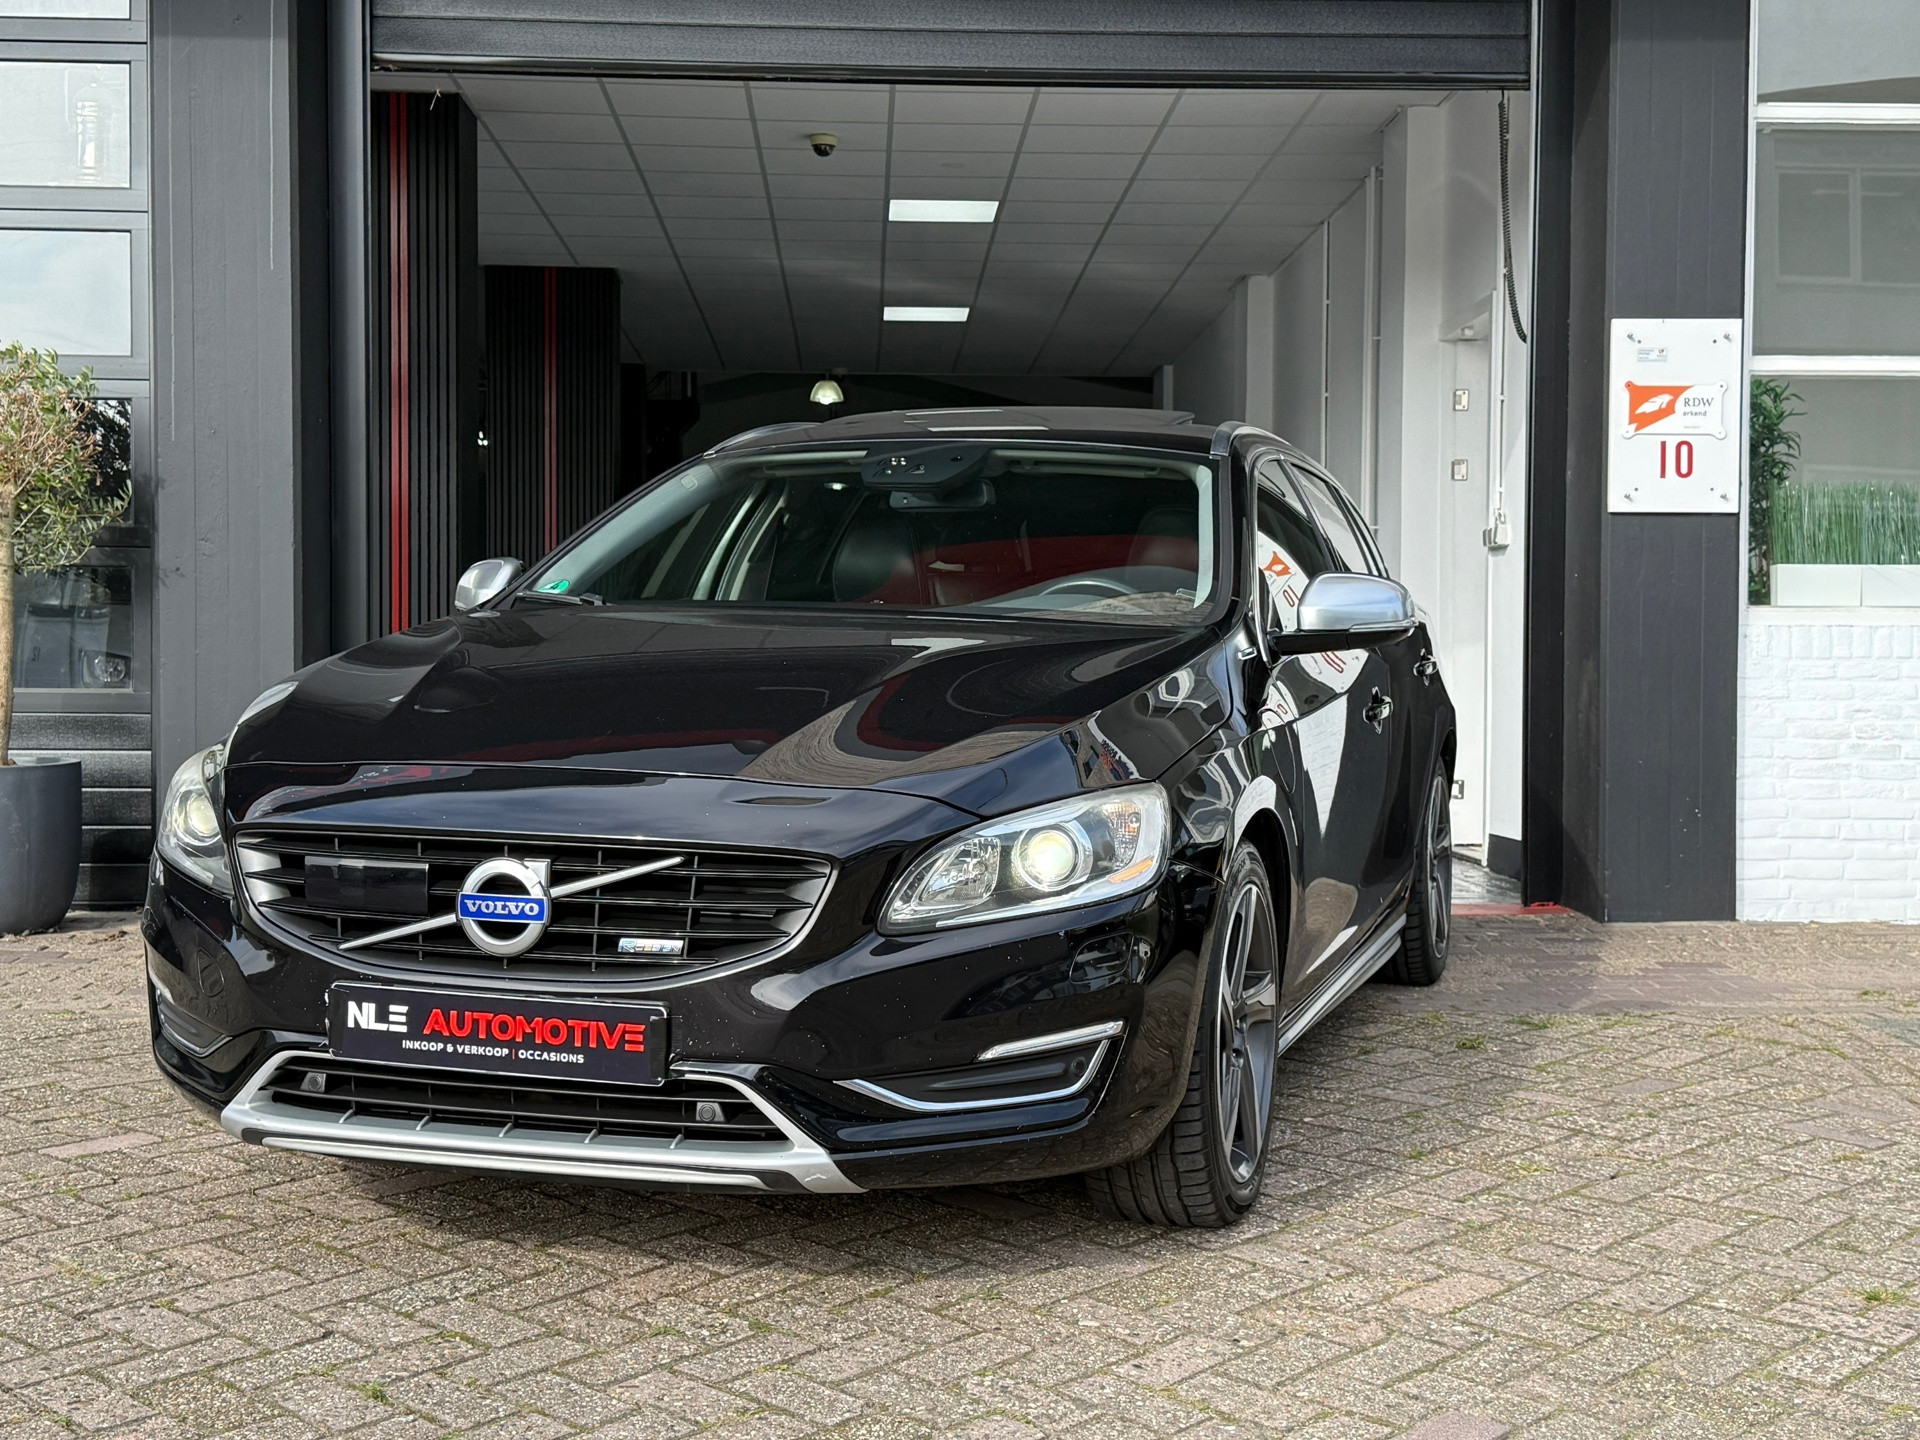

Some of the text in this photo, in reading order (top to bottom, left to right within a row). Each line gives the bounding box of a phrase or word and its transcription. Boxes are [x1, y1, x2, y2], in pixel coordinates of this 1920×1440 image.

[1684, 397, 1714, 407] RDW
[1659, 440, 1694, 479] 10
[464, 899, 540, 916] VOLVO
[347, 1000, 646, 1052] NLE AUTOMOTIVE
[402, 1039, 585, 1064] INKOOP & VERKOOP OCCASIONS
